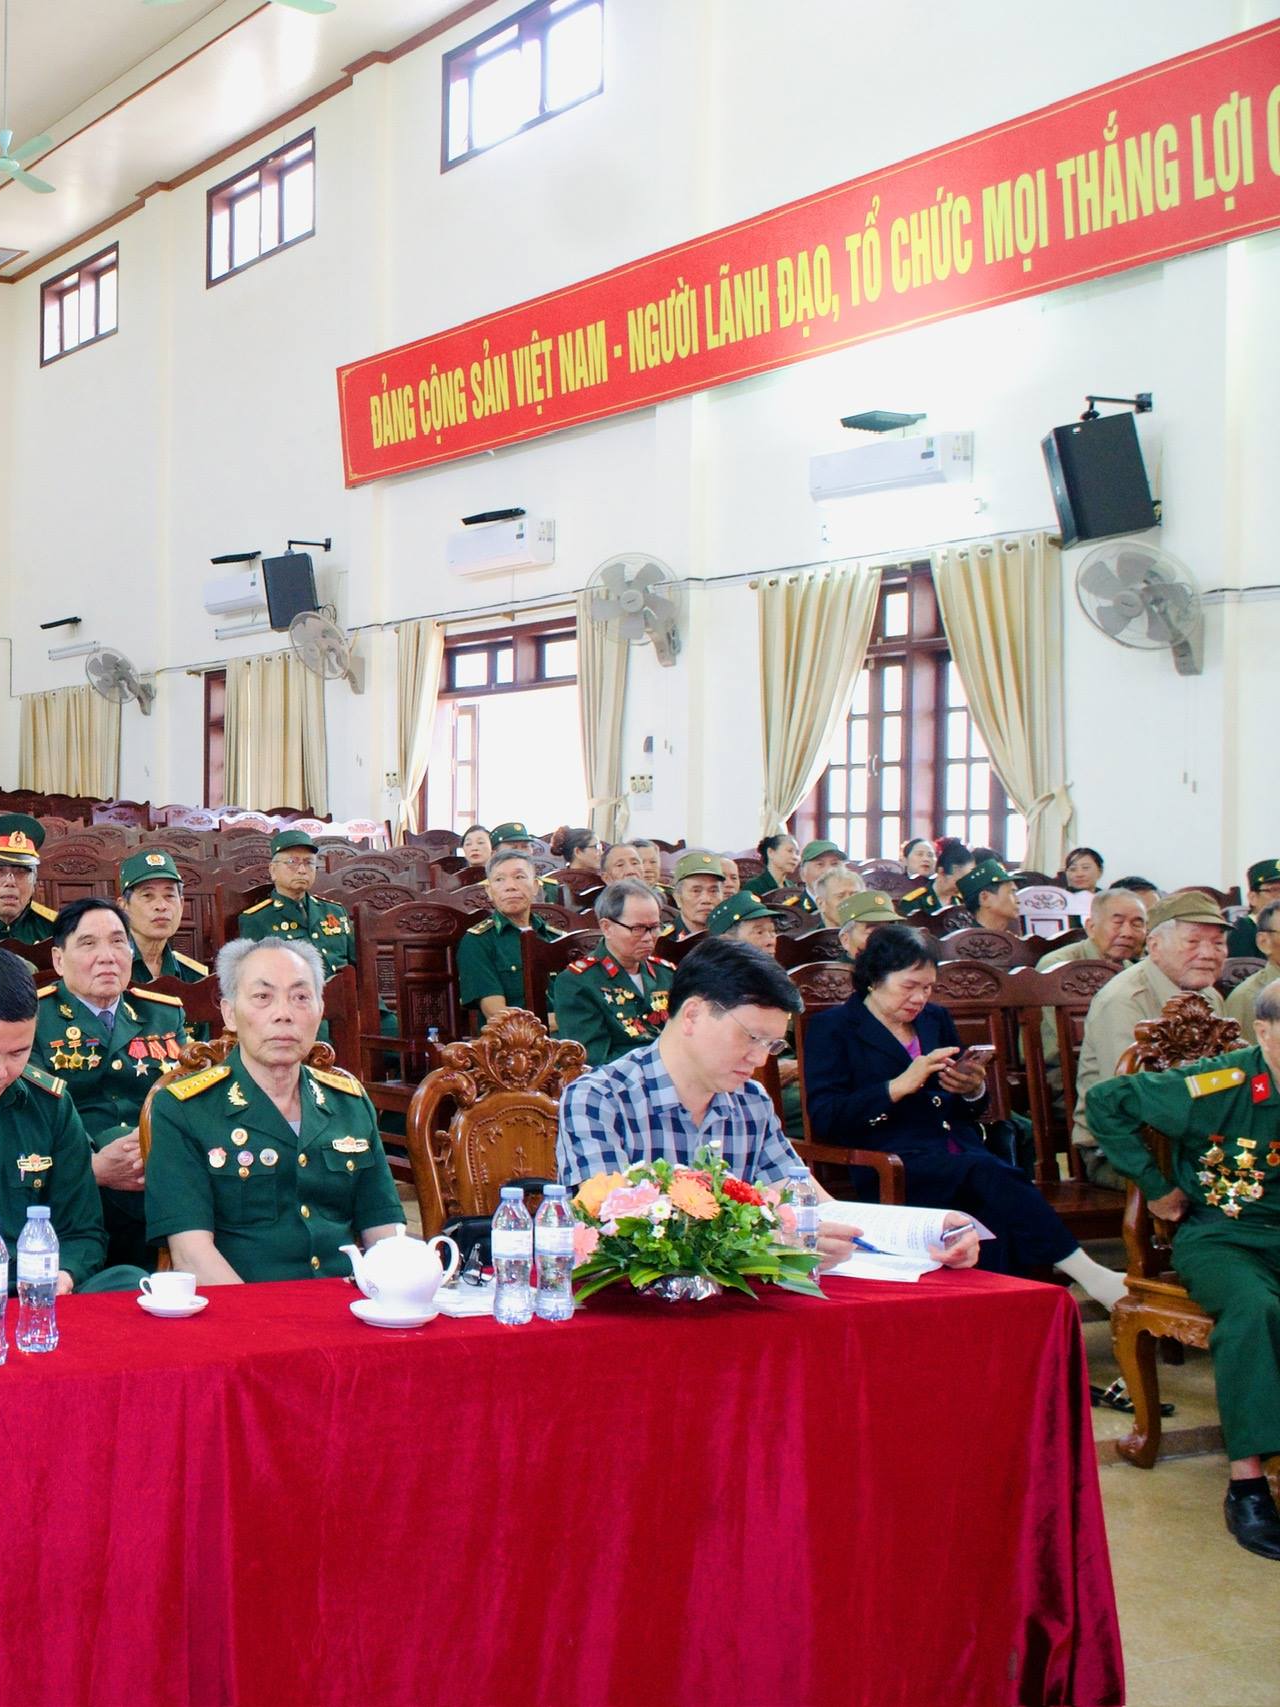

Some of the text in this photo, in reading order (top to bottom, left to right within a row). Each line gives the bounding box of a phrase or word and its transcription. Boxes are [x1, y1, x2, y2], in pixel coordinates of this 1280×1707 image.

[370, 373, 417, 449] ĐẢNG
[418, 363, 468, 445] CỘNG
[470, 338, 510, 420] SẢN
[512, 329, 553, 416] VIỆT
[558, 319, 609, 394] NAM
[627, 277, 700, 373] NGƯỜI
[704, 263, 772, 350] LÃNH
[776, 244, 841, 338] ĐẠO,
[845, 195, 883, 306] TỔ
[890, 187, 974, 294] CHỨC
[982, 168, 1049, 272] MỌI
[1056, 110, 1181, 240] THẮNG
[1191, 91, 1255, 211] LỢI
